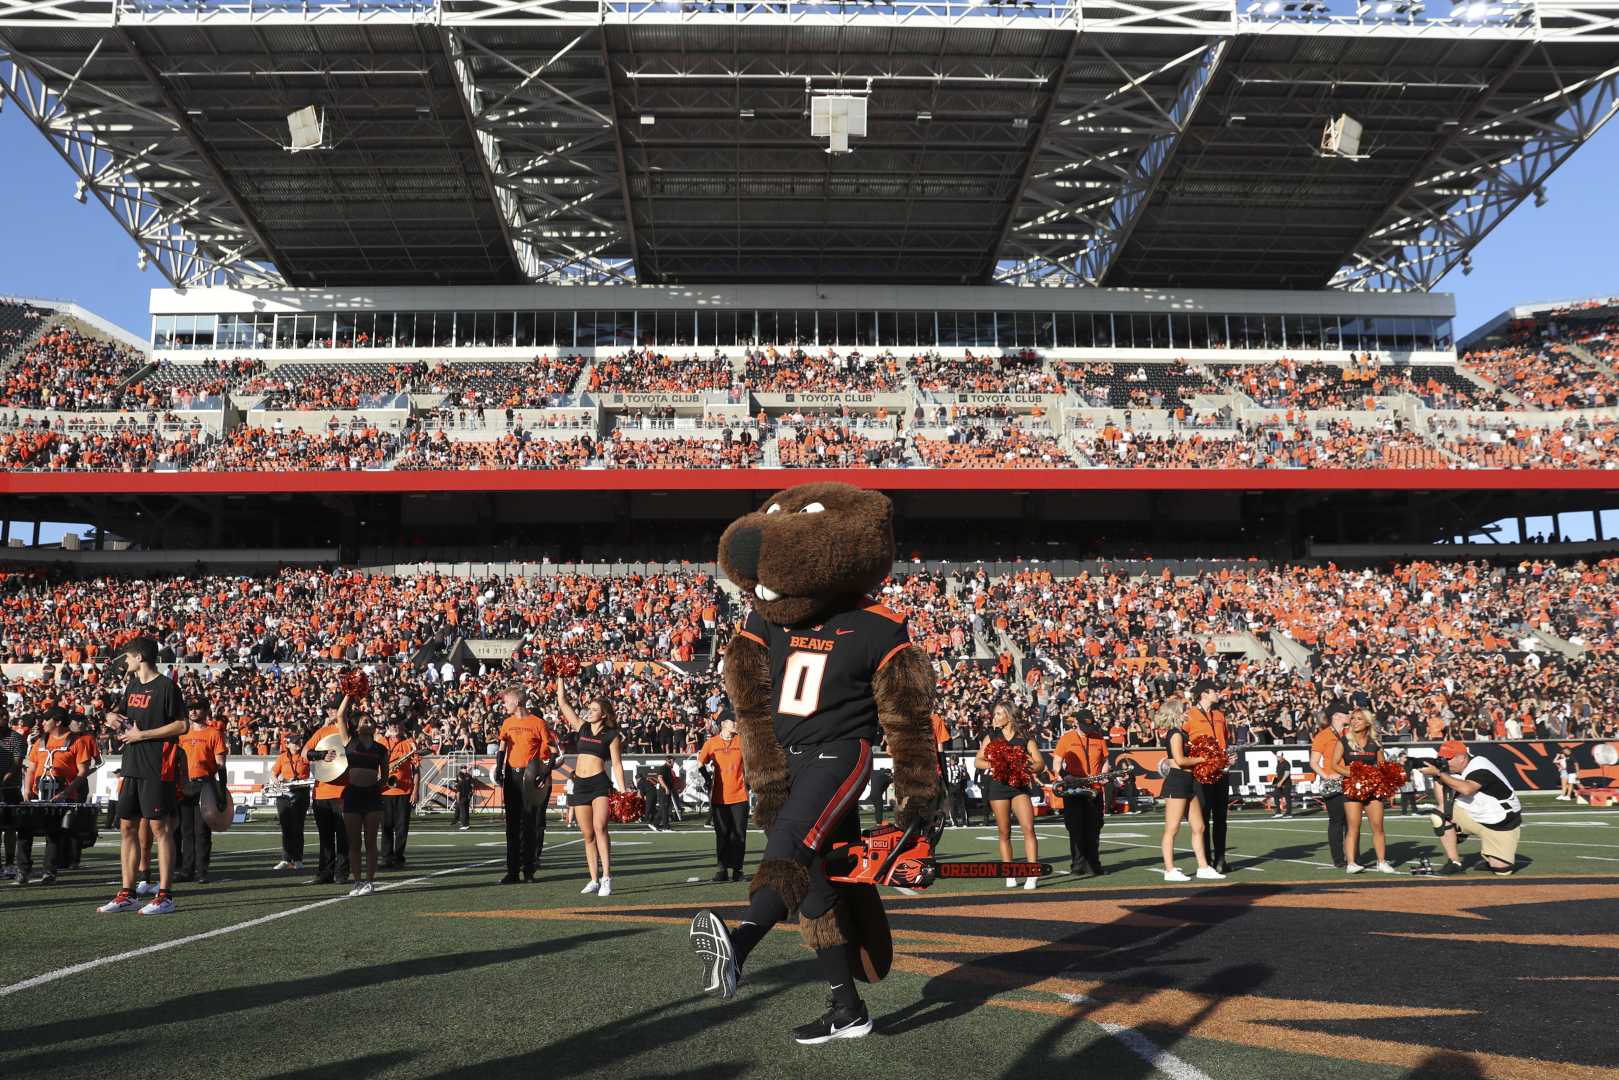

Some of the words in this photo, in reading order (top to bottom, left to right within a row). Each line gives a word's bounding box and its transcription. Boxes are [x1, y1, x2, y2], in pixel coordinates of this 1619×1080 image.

[627, 394, 668, 403] TOYOTA
[671, 394, 699, 403] CLUB
[800, 394, 841, 403] TOYOTA
[844, 394, 872, 403] CLUB
[972, 394, 1012, 403] TOYOTA
[1015, 394, 1042, 403] CLUB
[790, 636, 834, 651] BEAVS
[778, 650, 829, 718] 0
[128, 694, 152, 709] OSU
[941, 863, 998, 878] OREGON
[1002, 863, 1041, 878] STATE
